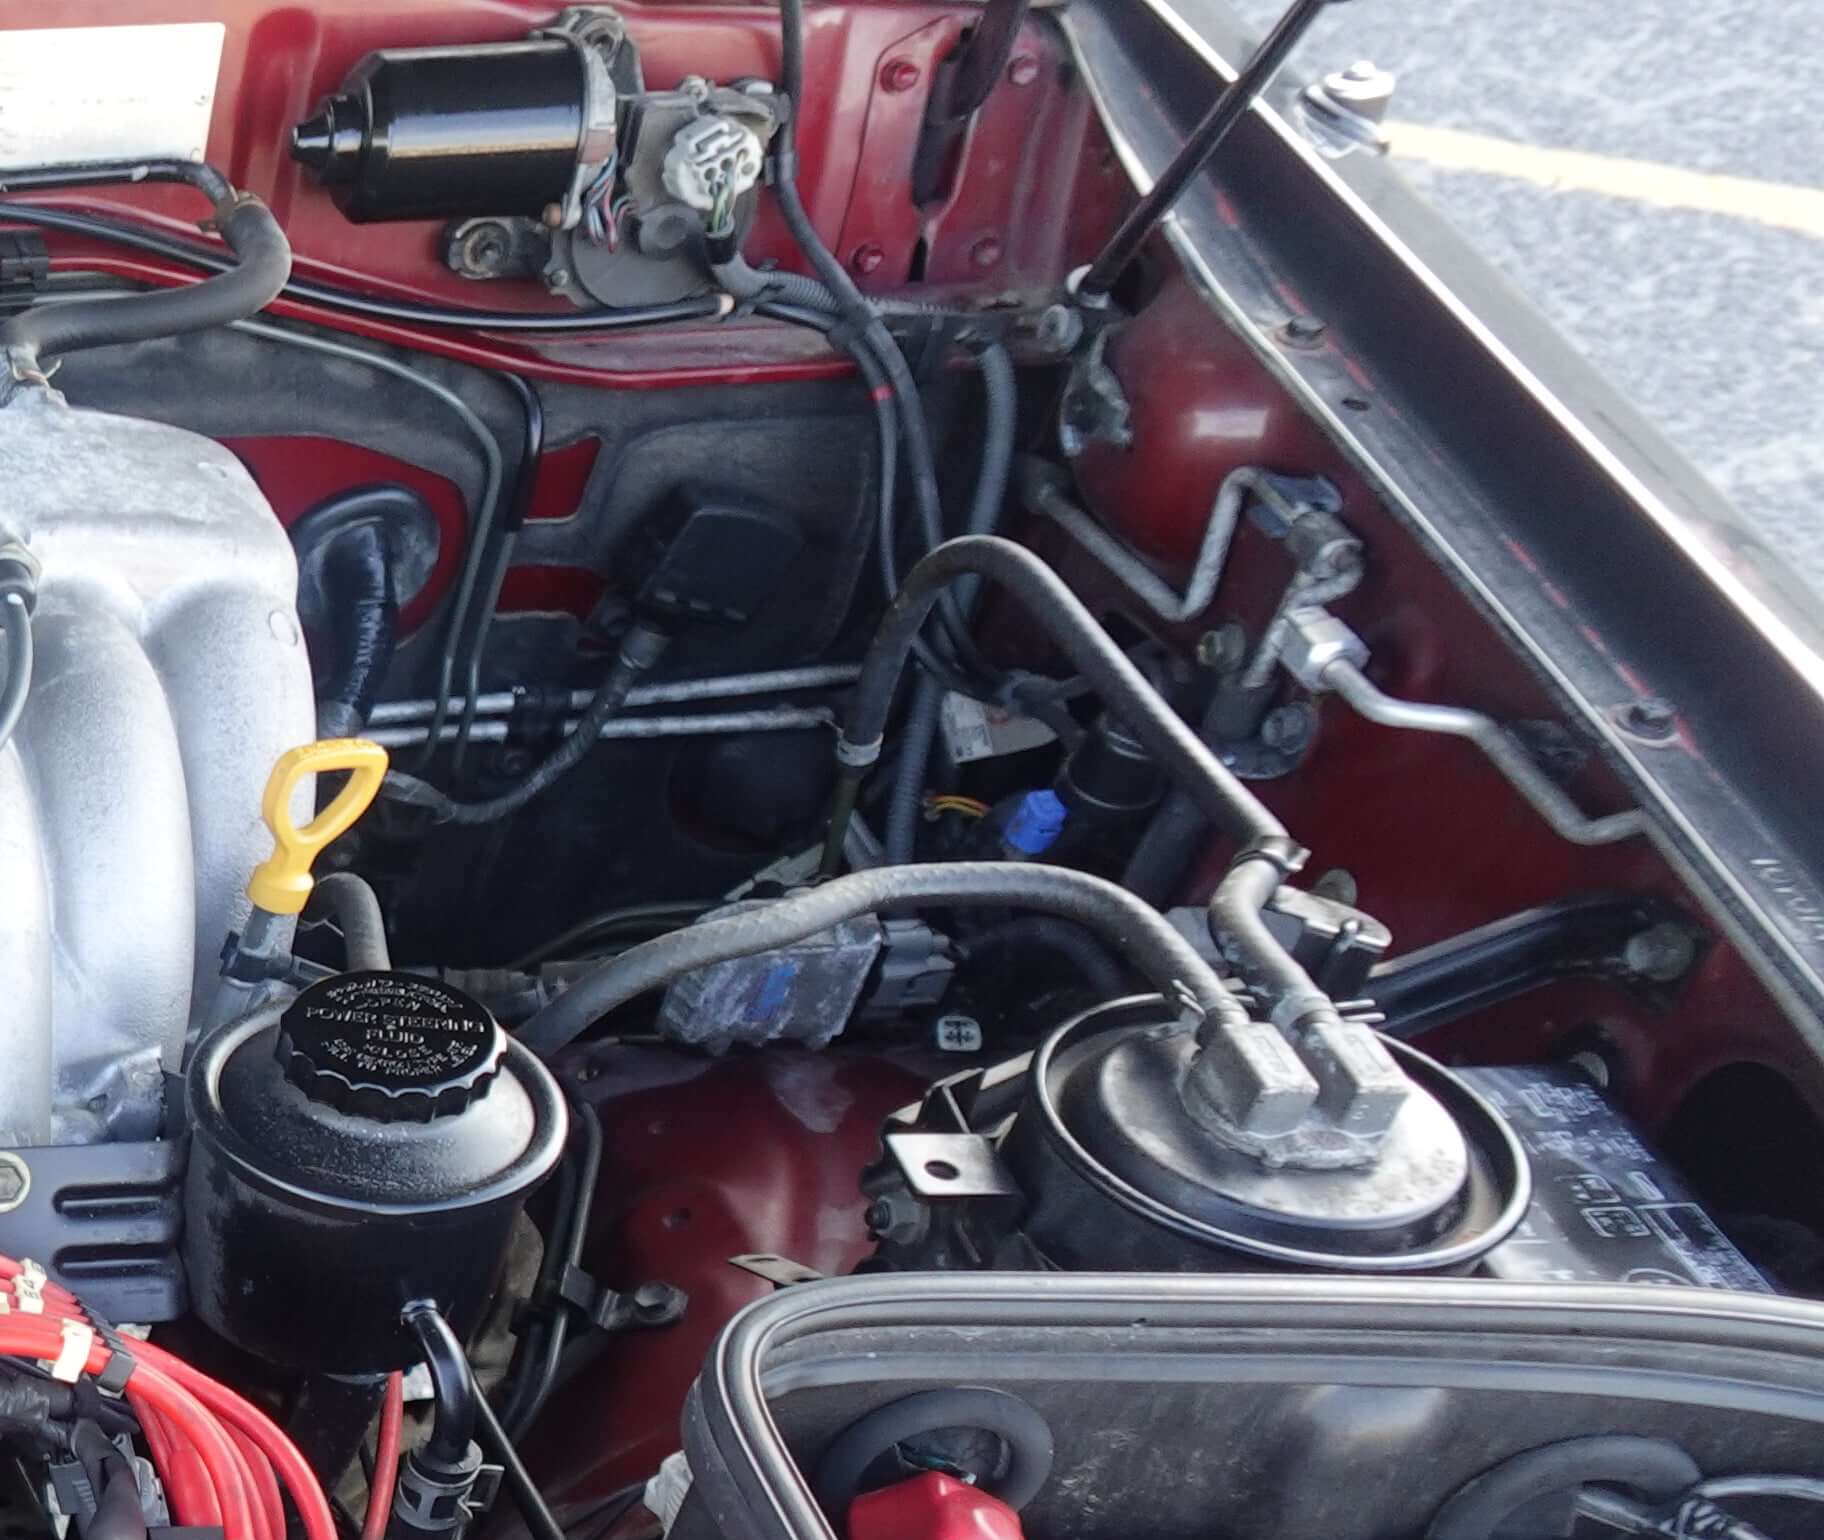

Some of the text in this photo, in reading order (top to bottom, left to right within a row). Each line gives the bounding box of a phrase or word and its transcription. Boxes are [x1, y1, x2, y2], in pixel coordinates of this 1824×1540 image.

[305, 1006, 486, 1033] POWER STEERING
[365, 1028, 425, 1045] FLUID
